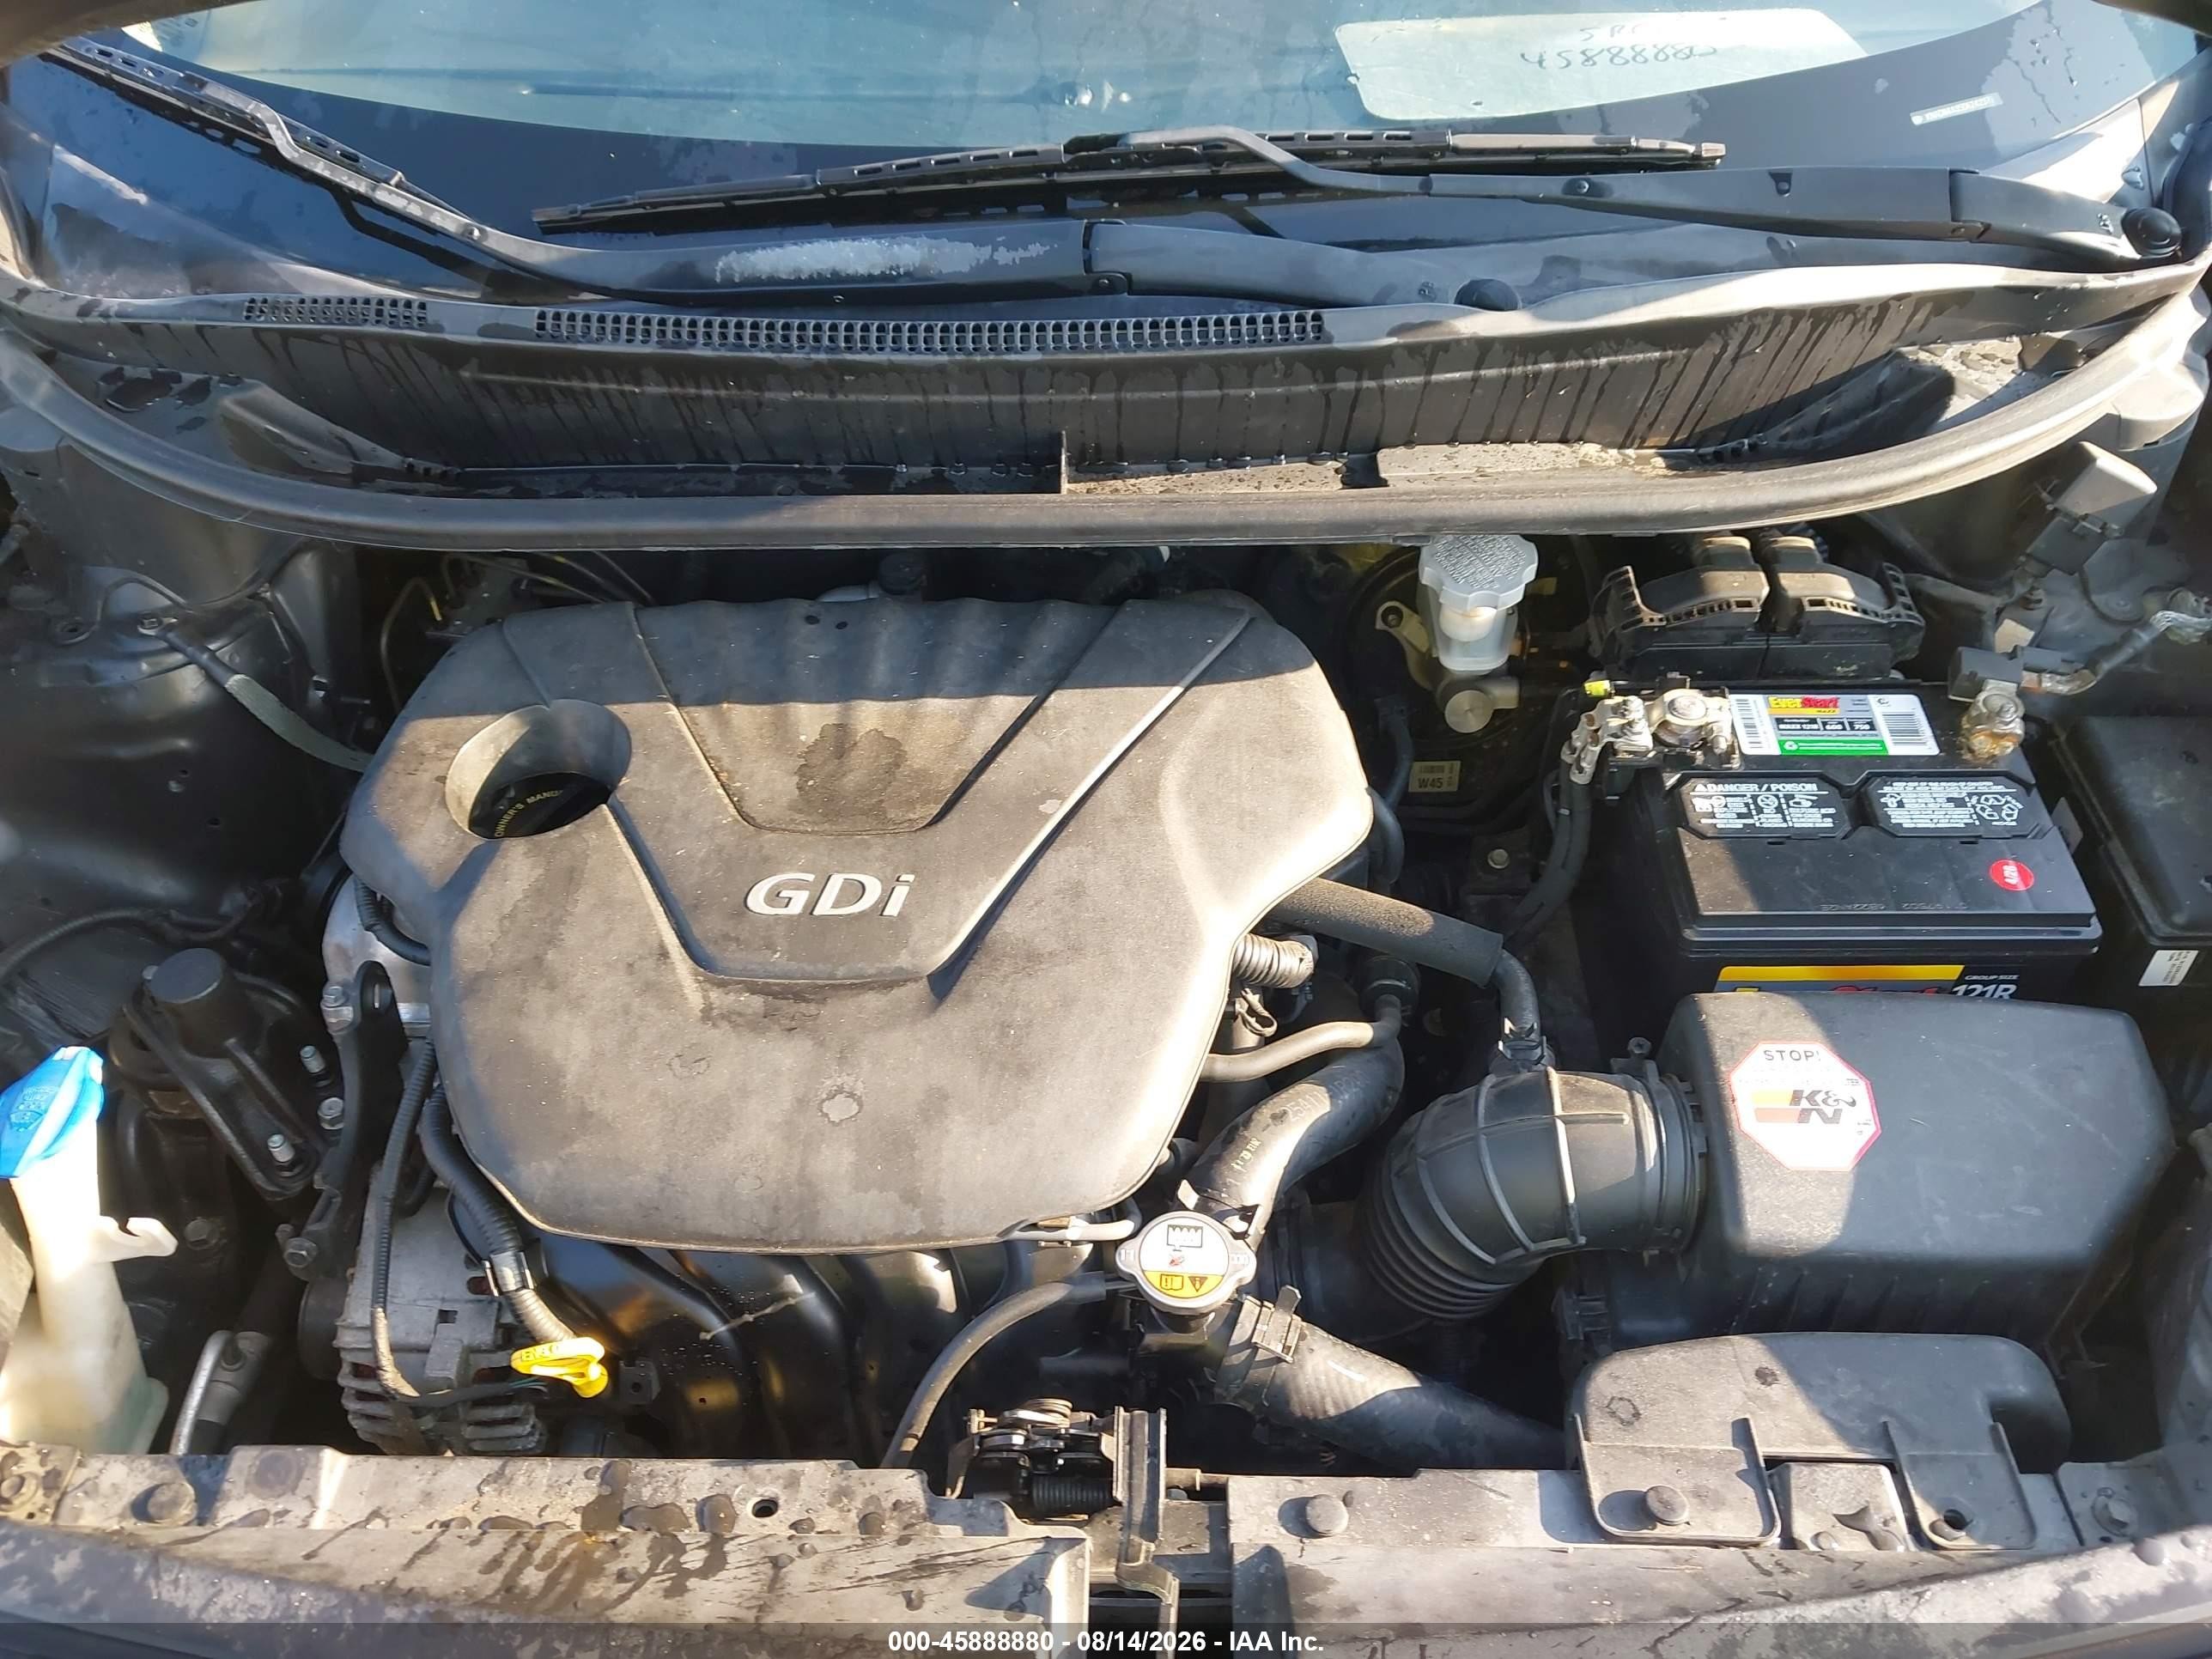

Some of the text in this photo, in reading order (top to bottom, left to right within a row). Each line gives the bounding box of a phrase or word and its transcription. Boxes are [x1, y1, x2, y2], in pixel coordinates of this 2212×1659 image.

[1418, 776, 1443, 789] W45
[1706, 783, 1759, 792] DANGER
[1771, 783, 1819, 792] POISON
[744, 872, 915, 916] GDi
[1951, 983, 2018, 1000] 121R
[1763, 1049, 1821, 1062] STOP!
[1790, 1090, 1856, 1124] K&N
